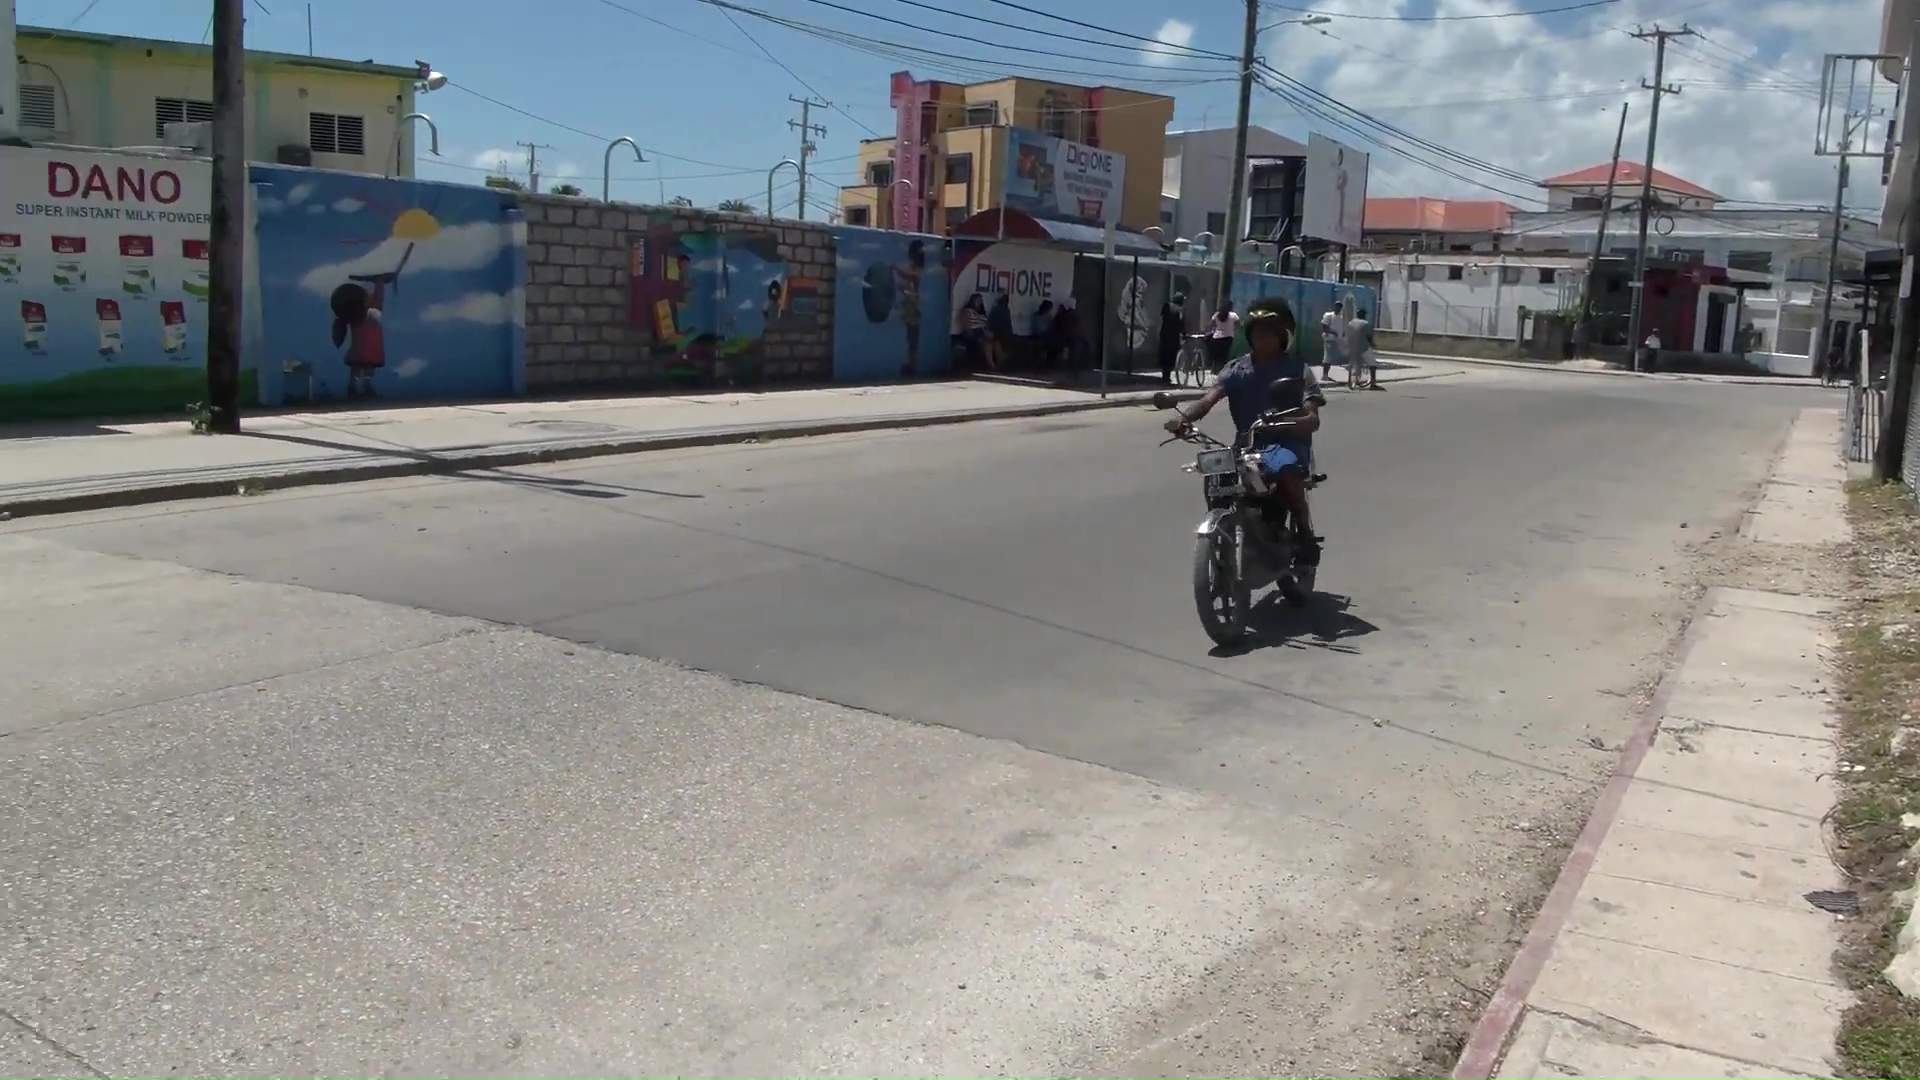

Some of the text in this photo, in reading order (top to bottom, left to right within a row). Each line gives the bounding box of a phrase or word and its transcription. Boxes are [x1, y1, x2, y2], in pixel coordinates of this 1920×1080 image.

[48, 161, 181, 204] DANO
[15, 203, 210, 224] SUPER INSTANT MILK POWDER
